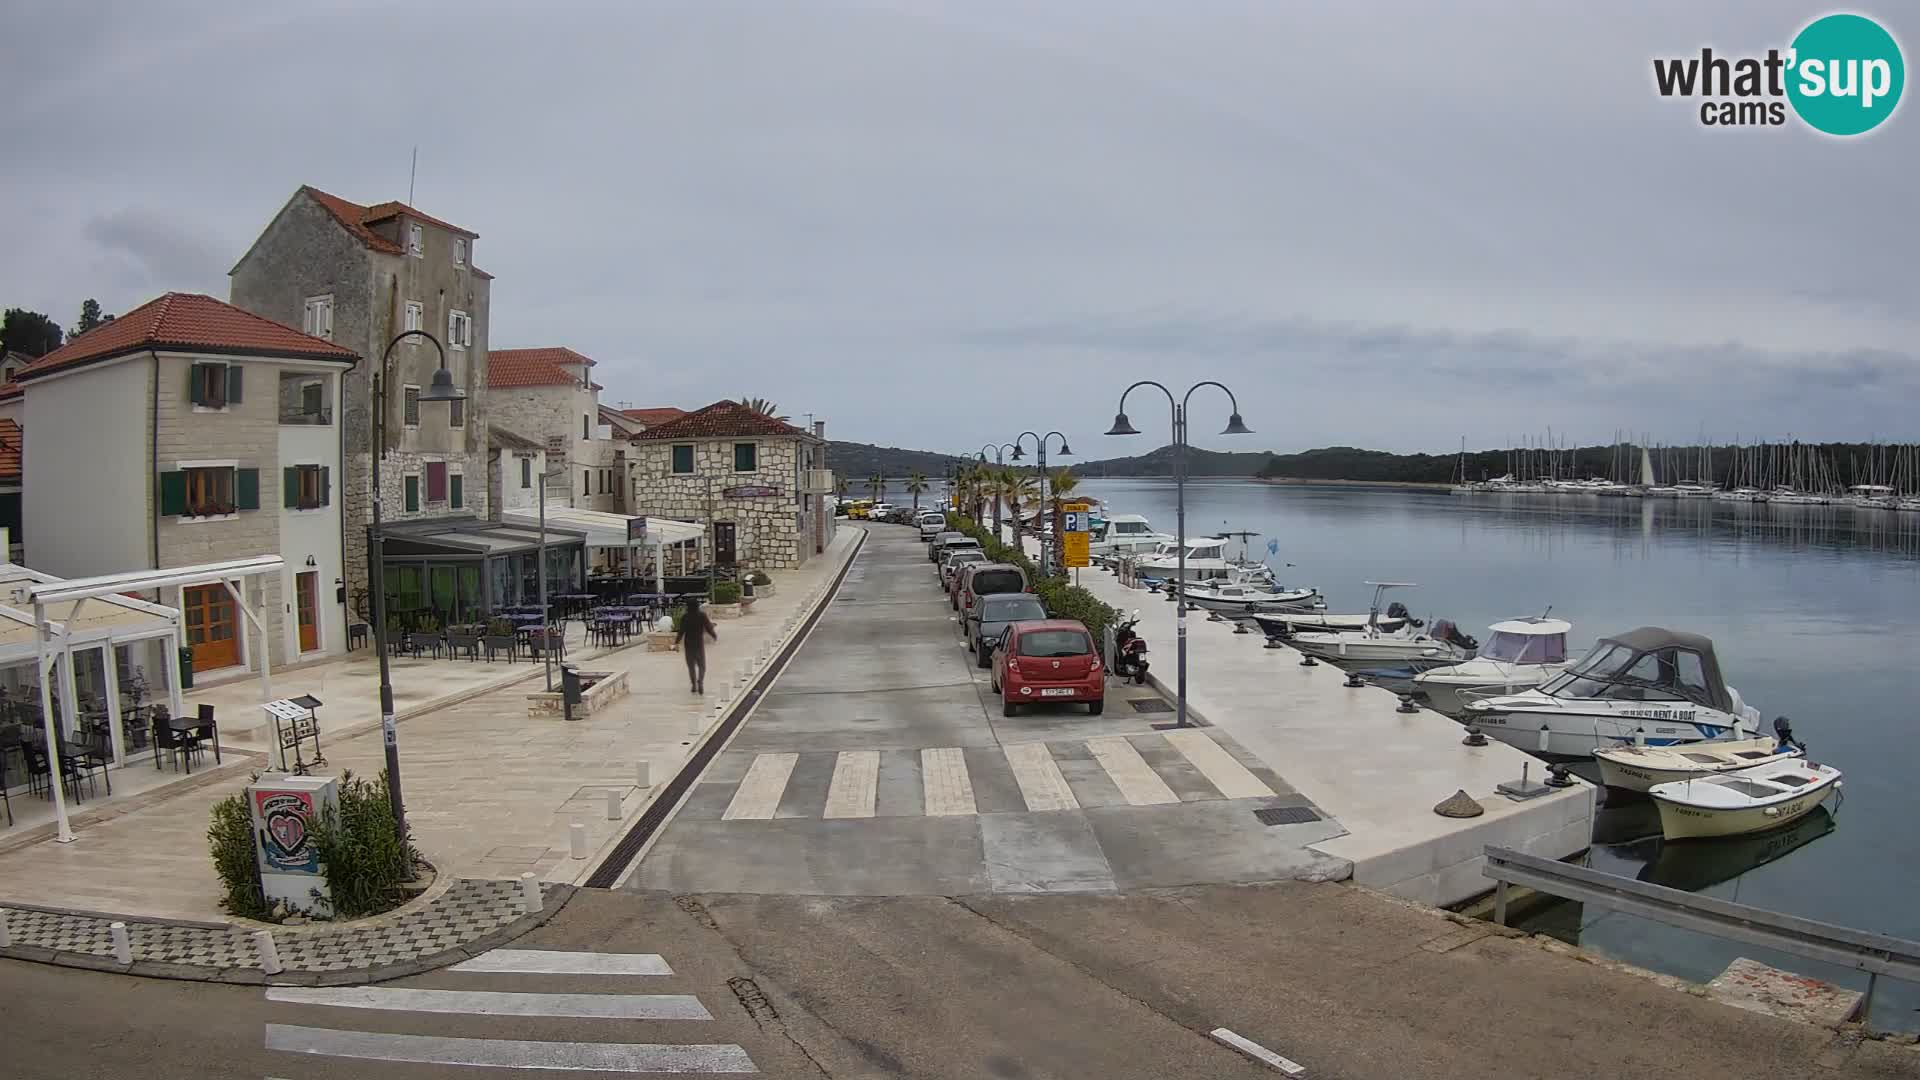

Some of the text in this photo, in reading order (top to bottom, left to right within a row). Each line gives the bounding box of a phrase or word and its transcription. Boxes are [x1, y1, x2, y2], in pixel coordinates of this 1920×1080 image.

[1065, 514, 1076, 530] P
[1653, 710, 1672, 719] RENT
[1673, 711, 1678, 720] A
[1679, 711, 1696, 721] BOAT
